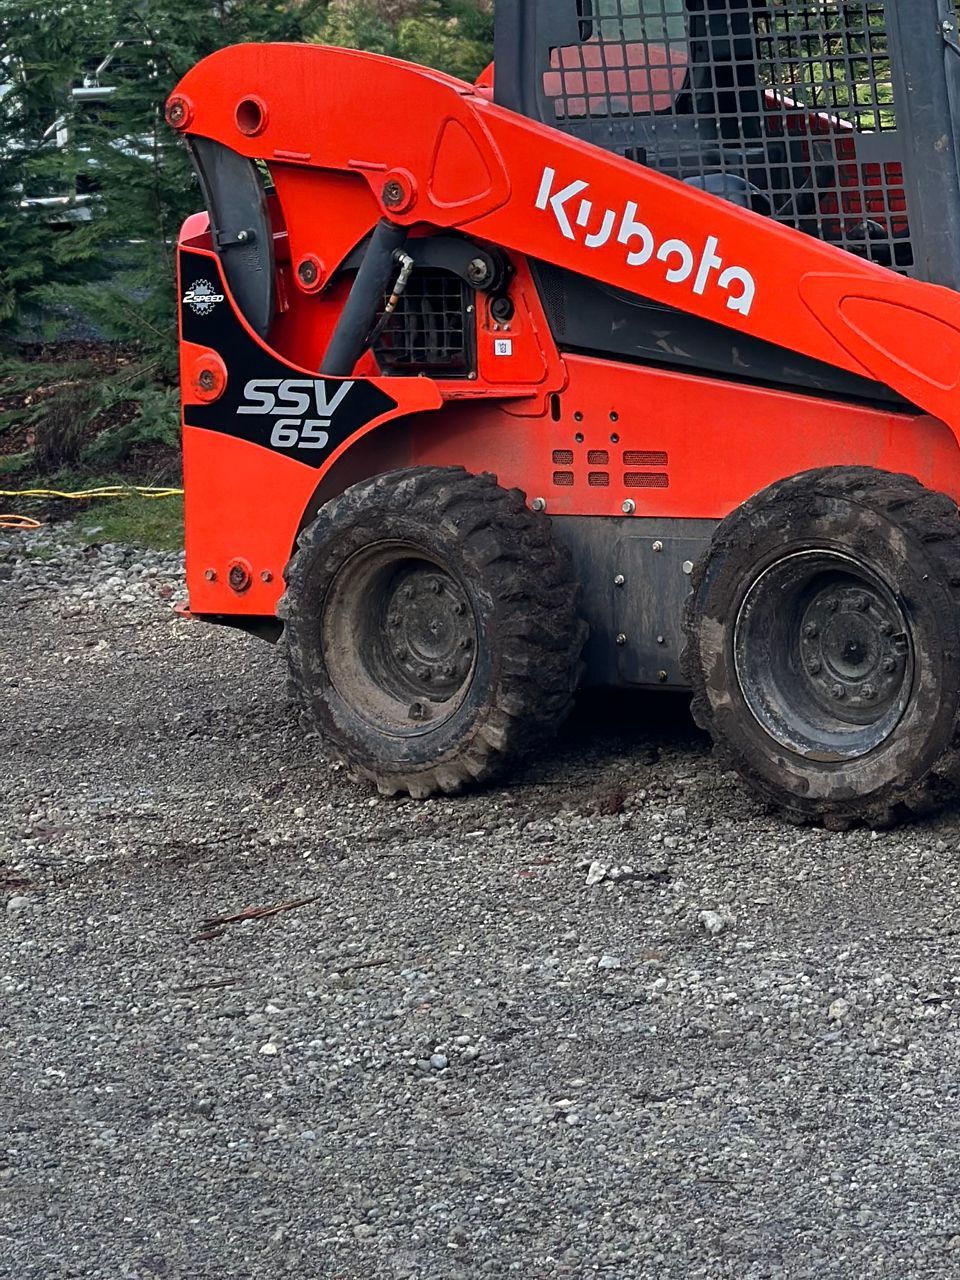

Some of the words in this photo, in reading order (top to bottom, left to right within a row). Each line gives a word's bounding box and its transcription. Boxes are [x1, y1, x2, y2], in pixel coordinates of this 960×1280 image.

[535, 166, 755, 317] Kubota
[236, 378, 356, 417] SSV
[270, 418, 332, 449] 65
